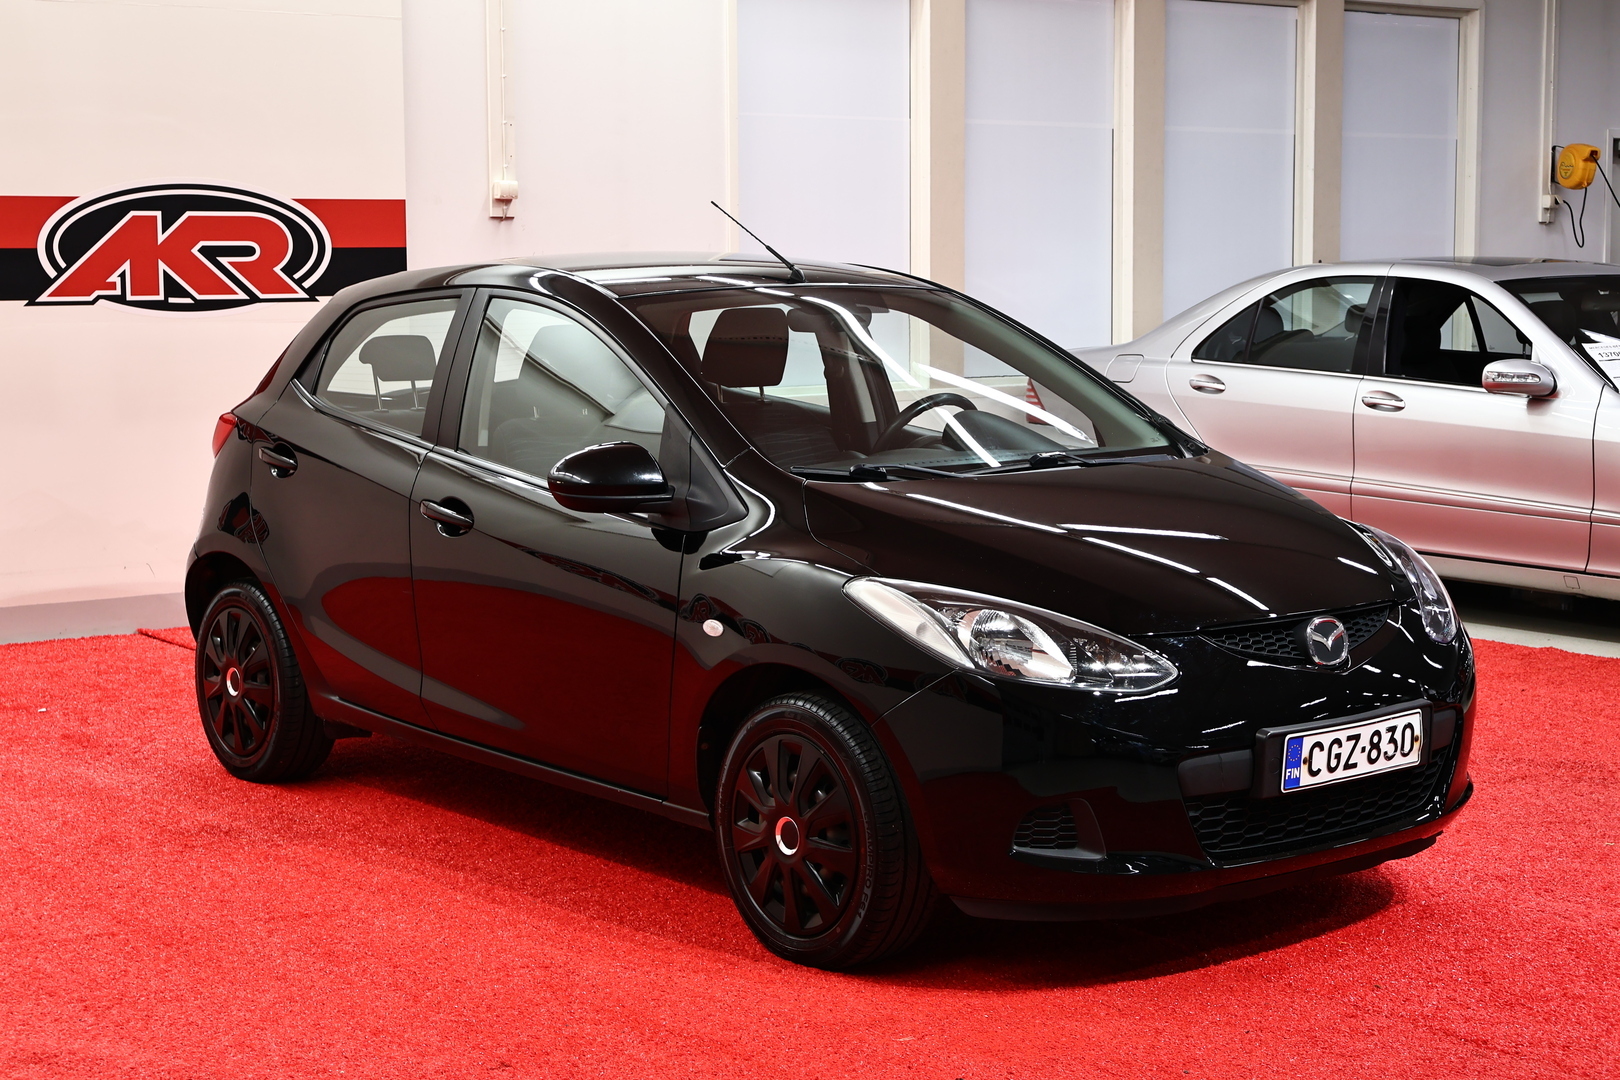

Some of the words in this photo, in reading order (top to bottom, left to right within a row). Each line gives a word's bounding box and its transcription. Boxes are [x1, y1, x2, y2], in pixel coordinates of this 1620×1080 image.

[35, 211, 310, 302] AKR
[1285, 767, 1300, 780] FIN
[1307, 722, 1415, 777] CGZ-830
